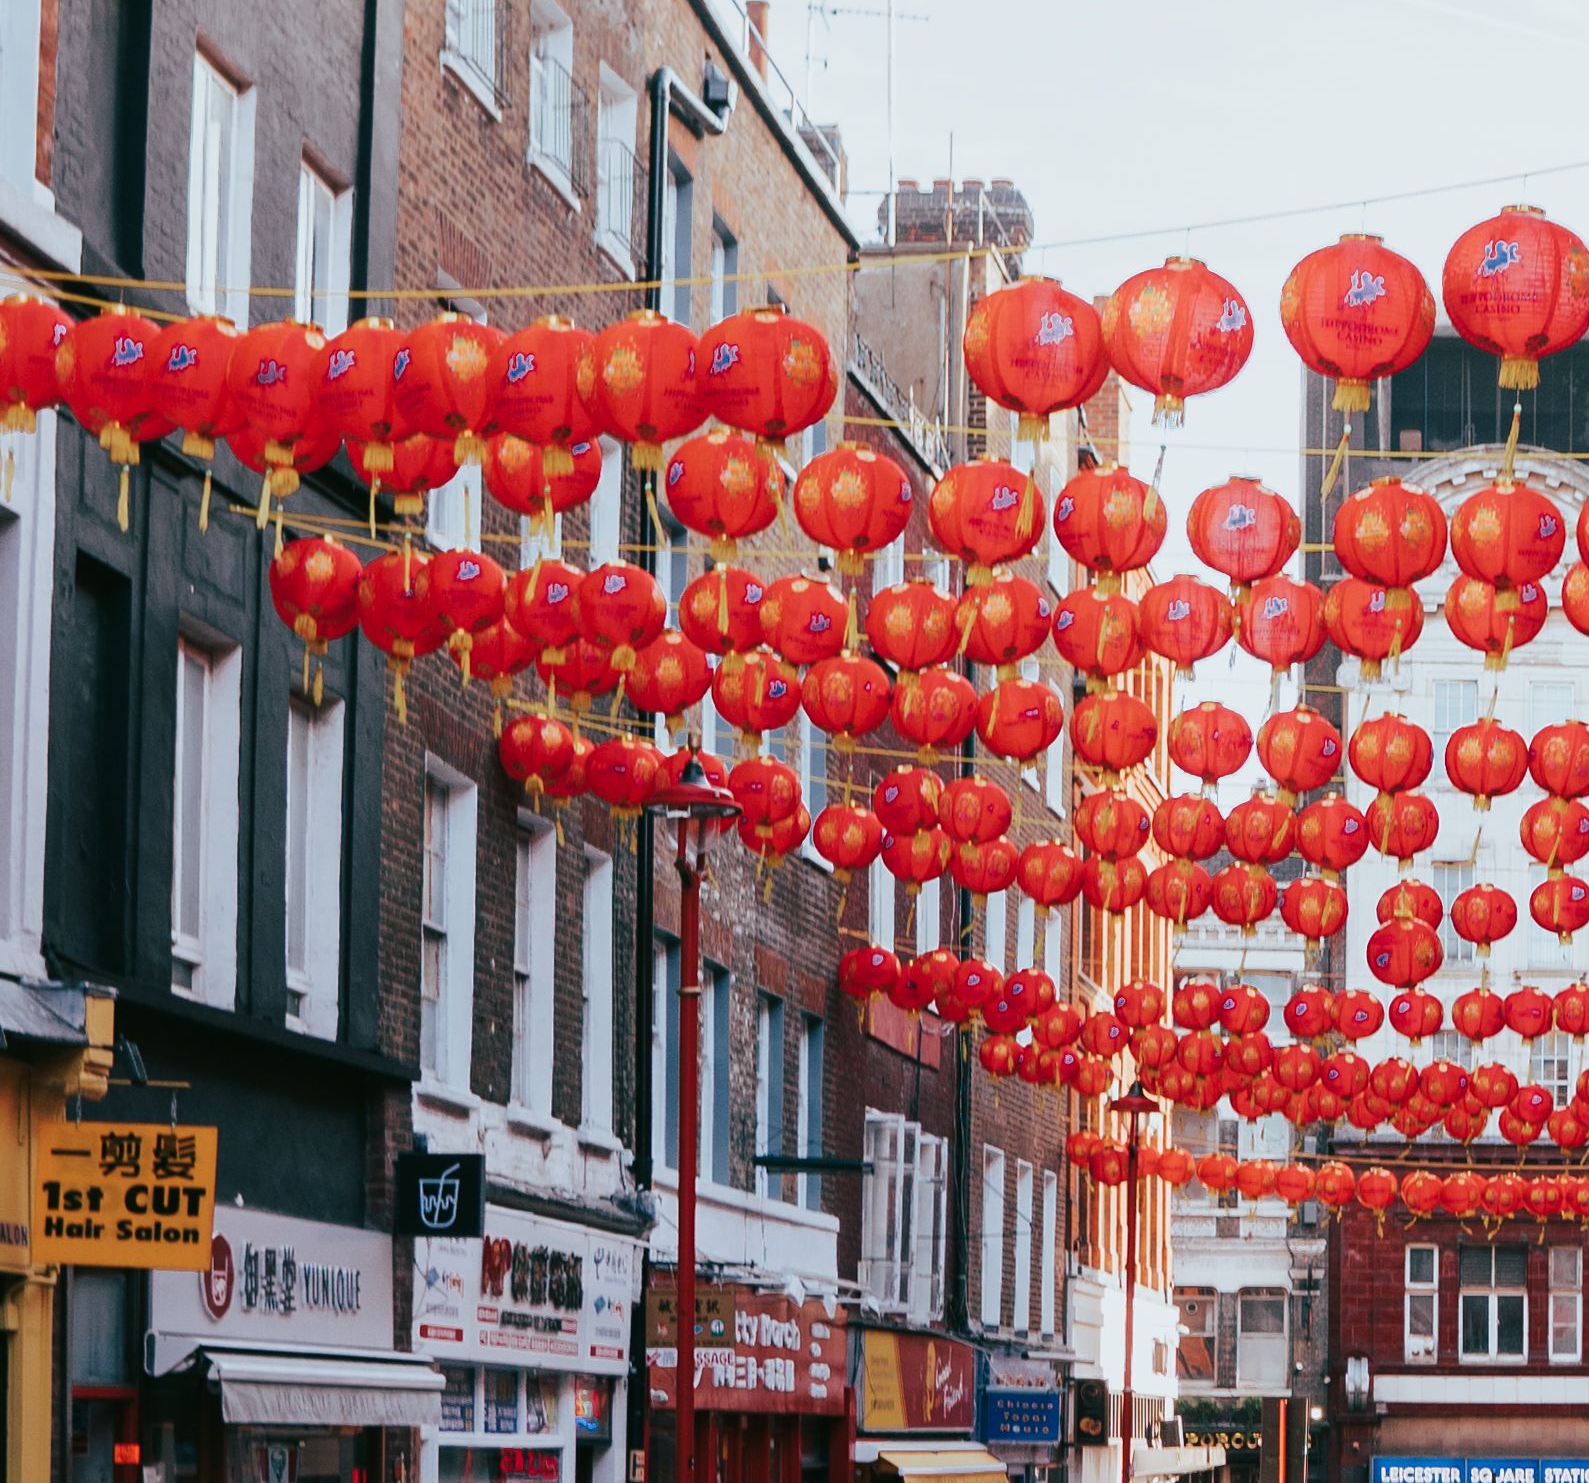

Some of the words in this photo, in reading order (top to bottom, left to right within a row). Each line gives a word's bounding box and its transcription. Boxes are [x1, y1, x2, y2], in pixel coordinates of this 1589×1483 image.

[1476, 304, 1520, 315] CASINO
[1321, 318, 1398, 336] HIPPODROME
[1337, 331, 1383, 346] CASINO
[51, 1131, 196, 1181] 一剪髮
[43, 1181, 104, 1213] 1st
[124, 1184, 207, 1217] CUT
[0, 1222, 28, 1246] ALON
[45, 1216, 104, 1239] Hair
[116, 1220, 199, 1244] Salon
[303, 1263, 361, 1312] YUNIQUE
[695, 1352, 735, 1367] SSAGE
[1381, 1466, 1461, 1483] LEICESTER
